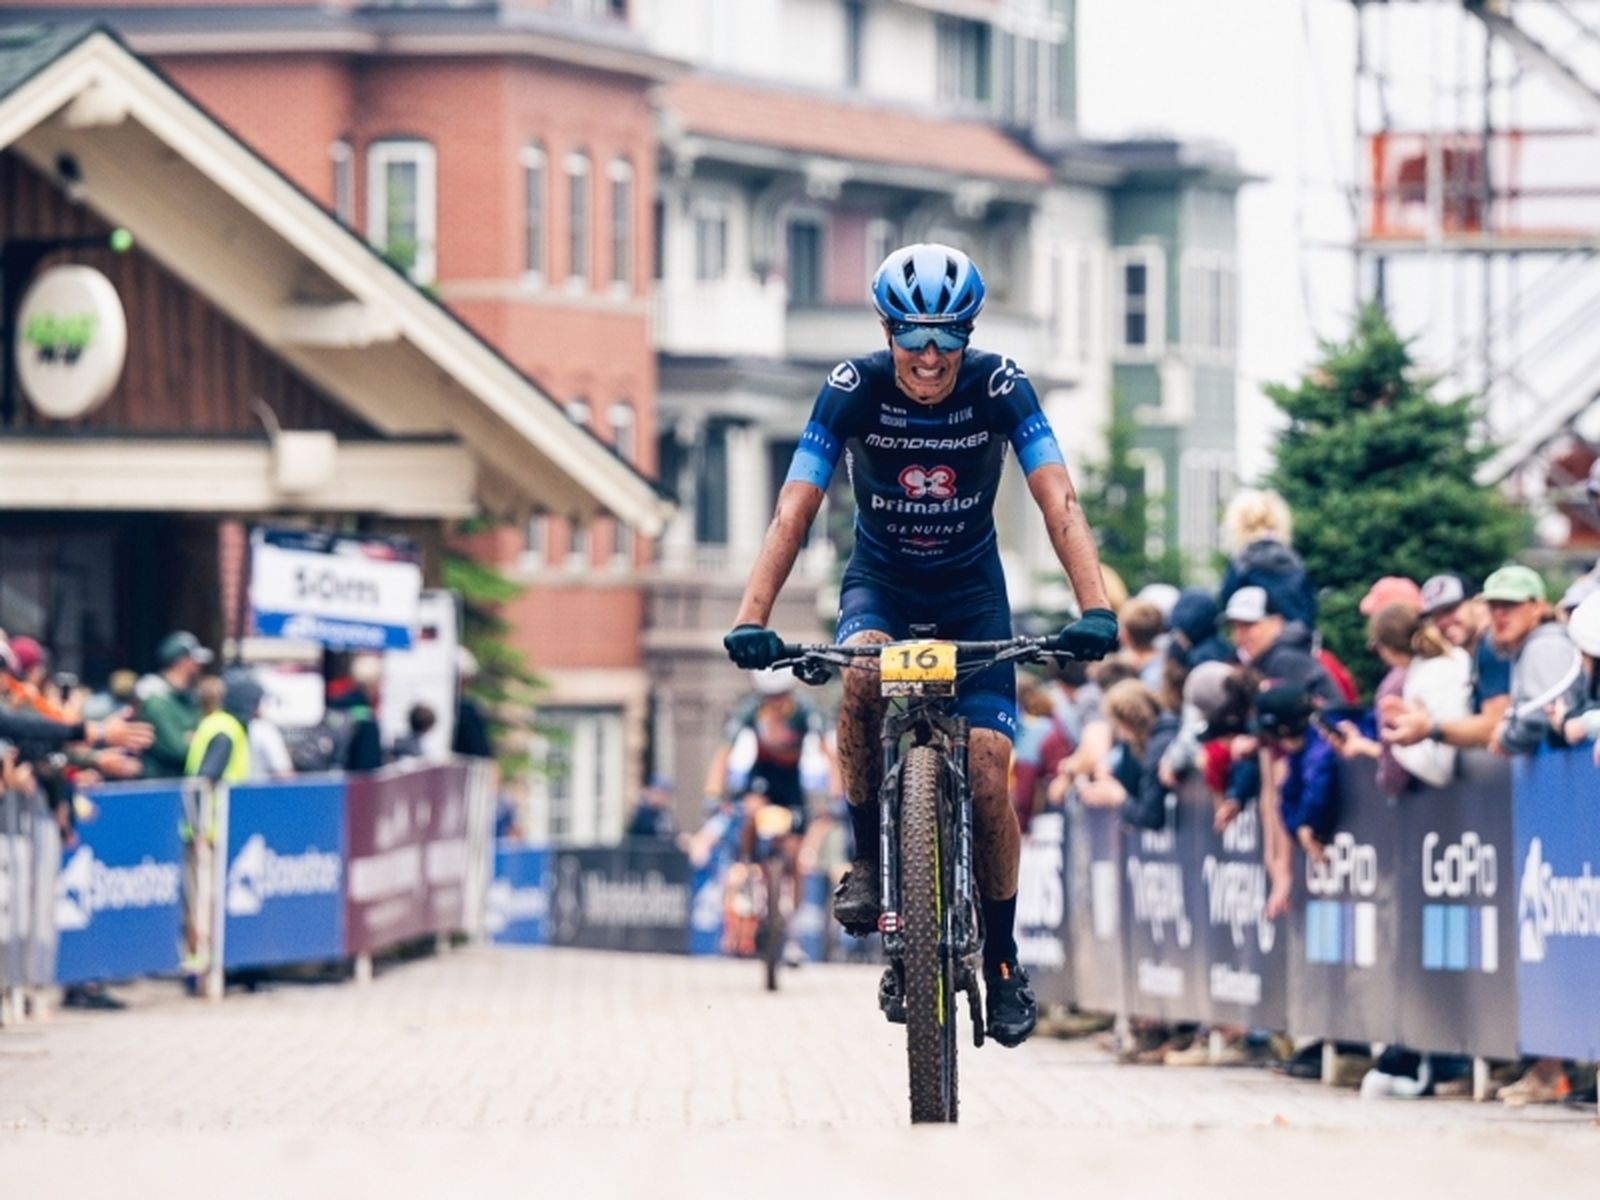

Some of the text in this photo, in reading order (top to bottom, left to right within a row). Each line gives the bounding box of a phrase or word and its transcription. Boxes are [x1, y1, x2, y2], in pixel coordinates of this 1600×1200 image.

[865, 431, 989, 450] MONDRAKER
[871, 491, 982, 515] primaflor
[886, 521, 966, 535] GENUINS
[899, 647, 938, 670] 16
[1421, 831, 1498, 898] GoPro
